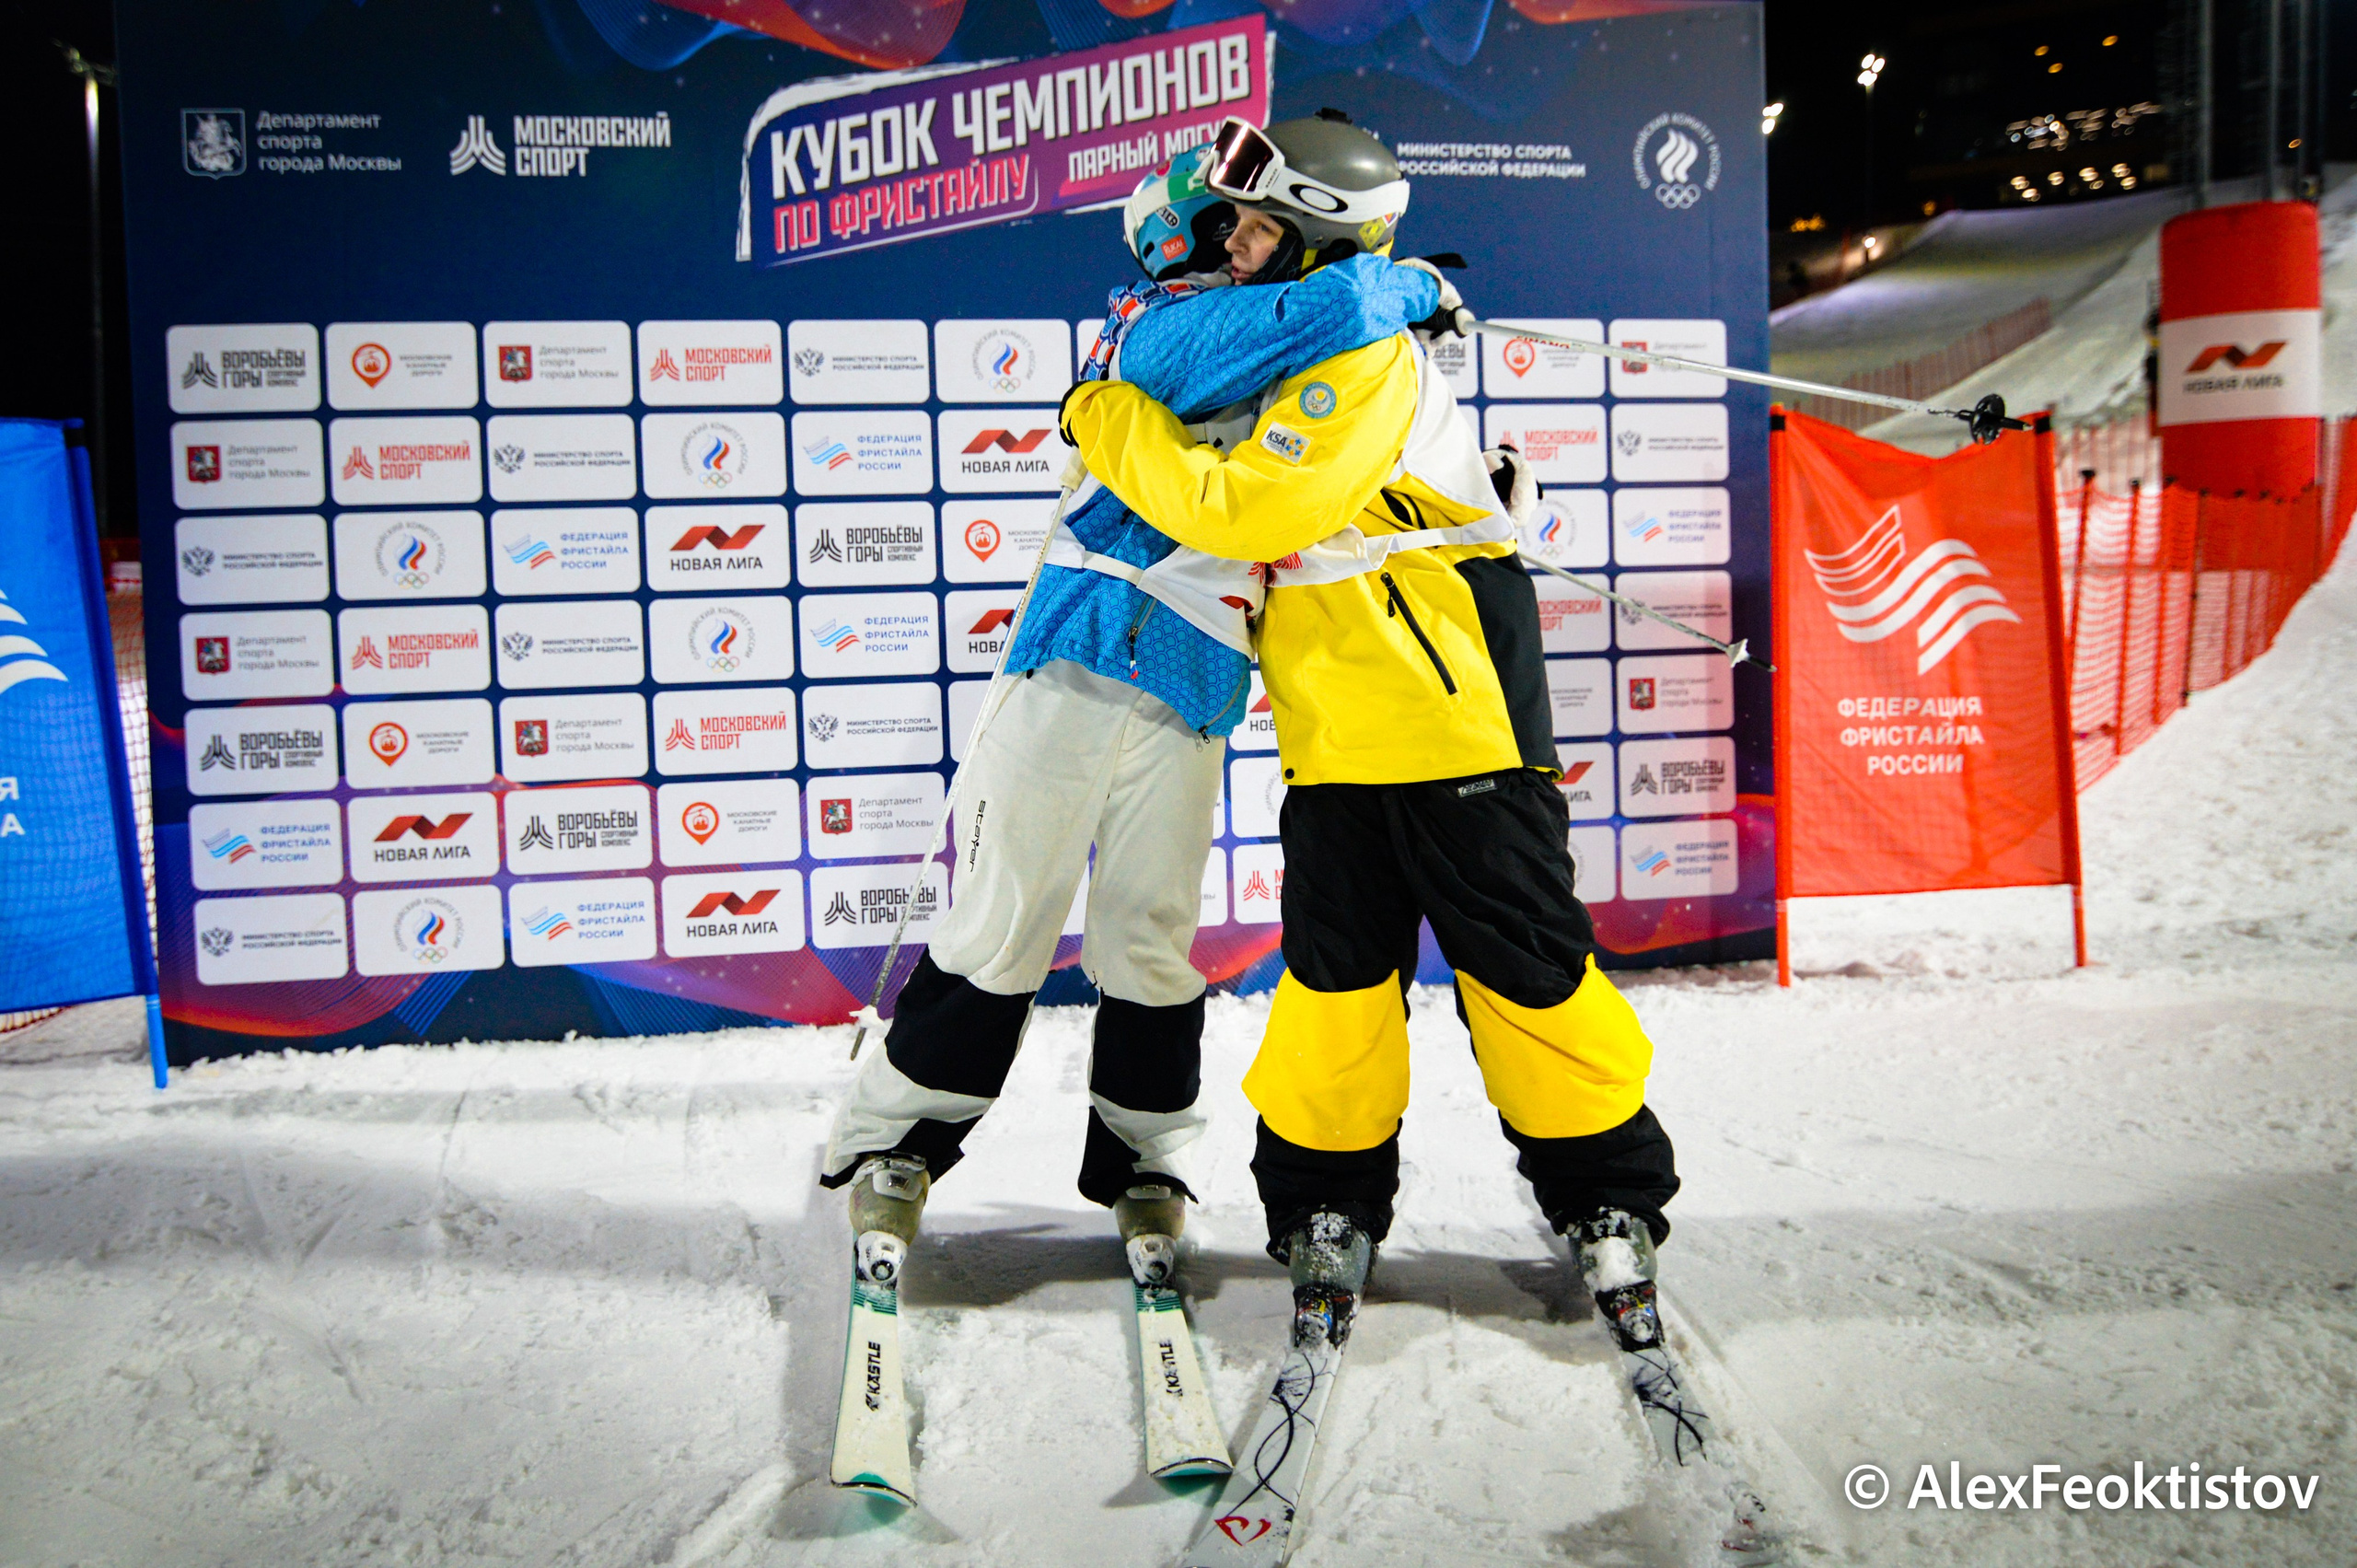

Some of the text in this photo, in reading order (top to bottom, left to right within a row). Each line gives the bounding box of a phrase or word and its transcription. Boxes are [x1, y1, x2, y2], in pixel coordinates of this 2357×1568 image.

[257, 110, 381, 130] Департамент
[771, 33, 1251, 200] КУБОК ЧЕМПИОНОВ
[514, 110, 671, 147] МОСКОВСКИЙ
[258, 134, 322, 151] спорта
[1397, 142, 1572, 160] МИНИСТЕРСТВО СПОРТА
[1632, 111, 1722, 191] ОЛИМПИЙСКИЙ КОМИТЕТ РОССИИ
[1068, 120, 1225, 183] ПАРНЫЙ МОГУ
[258, 154, 401, 173] города Москвы
[515, 147, 588, 177] СПОРТ
[1399, 158, 1586, 180] РОССИЙСКОЙ ФЕДЕРАЦИИ
[773, 153, 1031, 254] ПО ФРИСТАЙЛУ
[538, 344, 607, 357] Департамент
[684, 343, 772, 364] МОСКОВСКИЙ
[539, 357, 575, 368] спорта
[539, 367, 619, 381] города Москвы
[685, 364, 726, 381] СПОРТ
[2183, 373, 2283, 393] НОВАЯ ЛИГА
[857, 434, 923, 445] ФЕДЕРАЦИЯ
[1266, 430, 1288, 447] KSA
[378, 440, 470, 461] МОСКОВСКИЙ
[857, 446, 923, 458] ФРИСТАЙЛА
[379, 461, 423, 480] СПОРТ
[858, 461, 902, 470] РОССИИ
[961, 459, 1050, 473] НОВАЯ ЛИГА
[560, 530, 629, 543] ФЕДЕРАЦИЯ
[845, 523, 923, 544] ВОРОБЬЁВЫ
[561, 543, 629, 556] ФРИСТАЙЛА
[846, 545, 883, 563] ГОРЫ
[561, 559, 608, 569] РОССИИ
[670, 556, 762, 571] НОВАЯ ЛИГА
[1538, 595, 1602, 615] ОСКОВСКИЙ
[864, 614, 929, 627] ФЕДЕРАЦИЯ
[387, 628, 479, 651] МОСКОВСКИЙ
[865, 627, 929, 640] ФРИСТАЙЛА
[865, 643, 909, 652] РОССИИ
[969, 641, 1004, 654] НОВ
[388, 650, 431, 668] СПОРТ
[1838, 696, 1983, 717] ФЕДЕРАЦИЯ
[554, 716, 622, 731] Департамент
[699, 710, 786, 733] МОСКОВСКИЙ
[846, 716, 931, 727] МИНИСТЕРСТВО СПОРТА
[846, 724, 938, 735] РОССИЙСКОЙ ФЕДЕРАЦИИ
[1249, 719, 1275, 731] НОВ
[239, 727, 323, 750] ВОРОБЬЁВЫ
[555, 730, 591, 742] спорта
[700, 732, 740, 749] СПОРТ
[1840, 723, 1985, 747] ФРИСТАЙЛА
[555, 738, 634, 754] города Москвы
[240, 750, 280, 770] ГОРЫ
[1867, 753, 1964, 776] РОССИИ
[857, 796, 923, 809] Департамент
[557, 807, 638, 830] ВОРОБЬЁВЫ
[858, 808, 893, 820] спорта
[260, 822, 331, 836] ФЕДЕРАЦИЯ
[859, 817, 935, 832] города Москвы
[261, 835, 331, 850] ФРИСТАЙЛА
[558, 830, 597, 849] ГОРЫ
[970, 799, 986, 873] stayer
[261, 852, 309, 863] РОССИИ
[374, 845, 470, 863] НОВАЯ ЛИГА
[861, 885, 936, 906] ВОРОБЬВЫ
[577, 900, 644, 913] ФЕДЕРАЦИЯ
[861, 906, 898, 924] ГОРЫ
[577, 912, 645, 926] ФРИСТАЙЛА
[578, 928, 624, 939] РОССИИ
[686, 920, 778, 938] НОВАЯ ЛИГА
